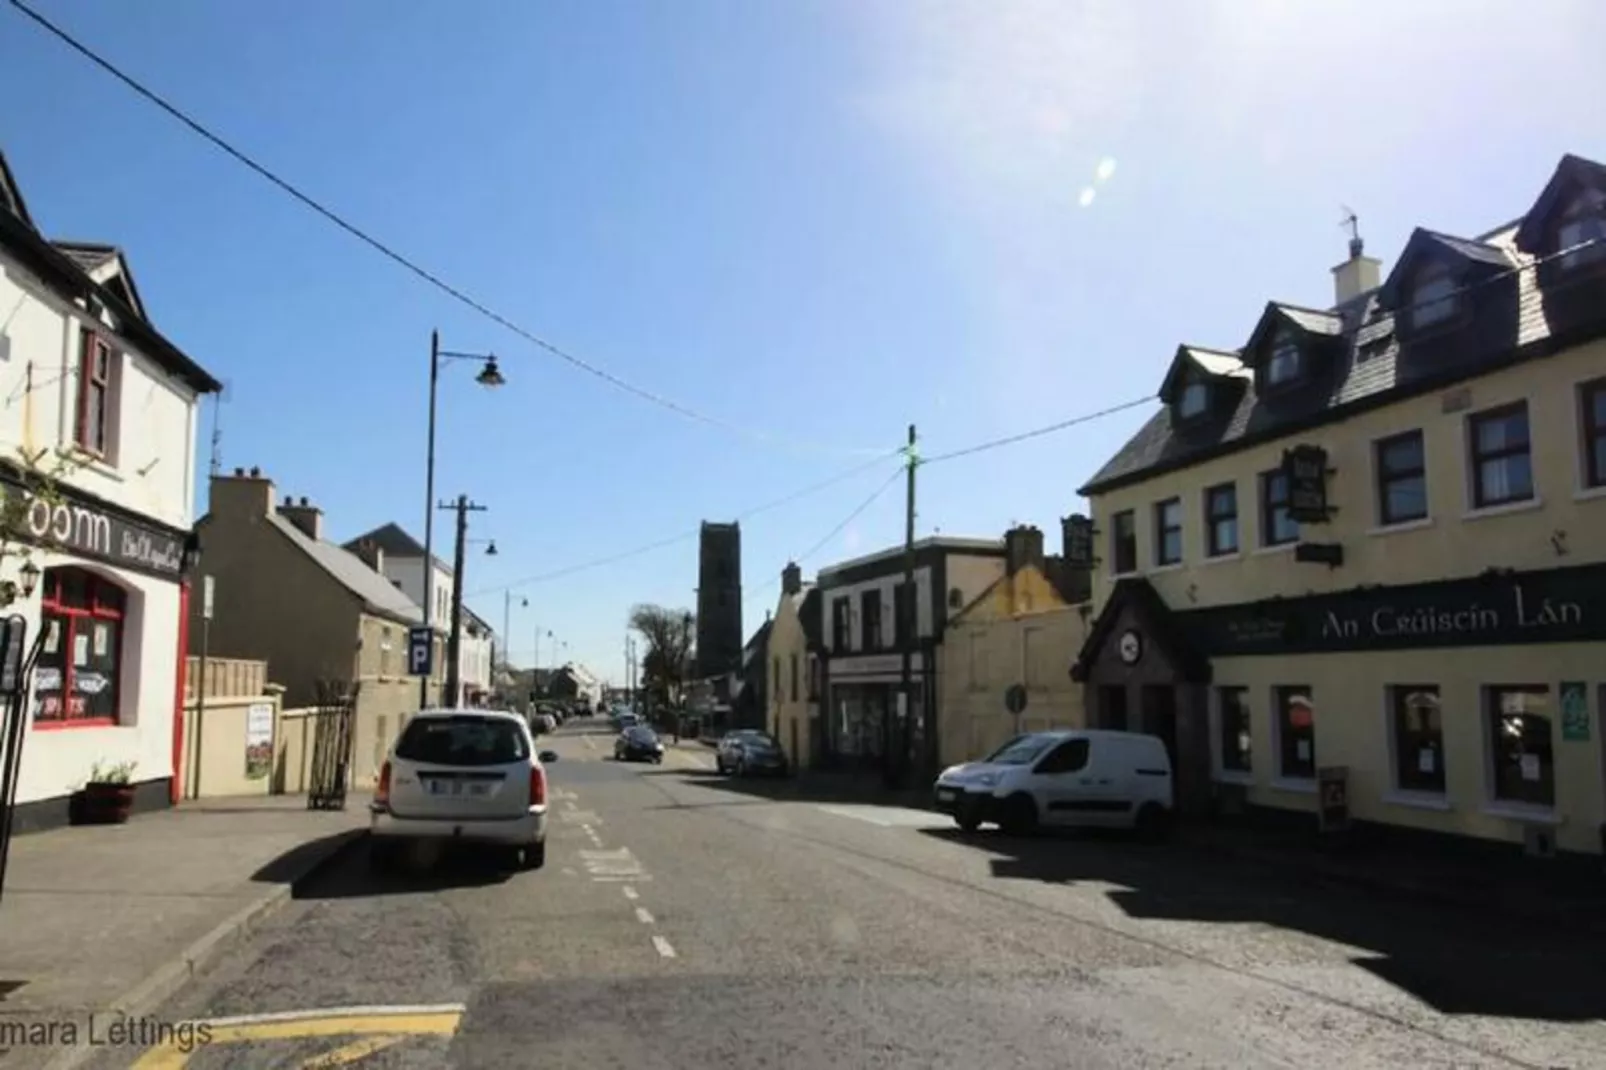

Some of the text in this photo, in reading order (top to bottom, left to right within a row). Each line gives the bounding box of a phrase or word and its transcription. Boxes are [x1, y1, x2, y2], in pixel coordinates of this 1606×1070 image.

[1322, 608, 1359, 639] An
[1513, 584, 1582, 626] Lán
[413, 645, 428, 671] P
